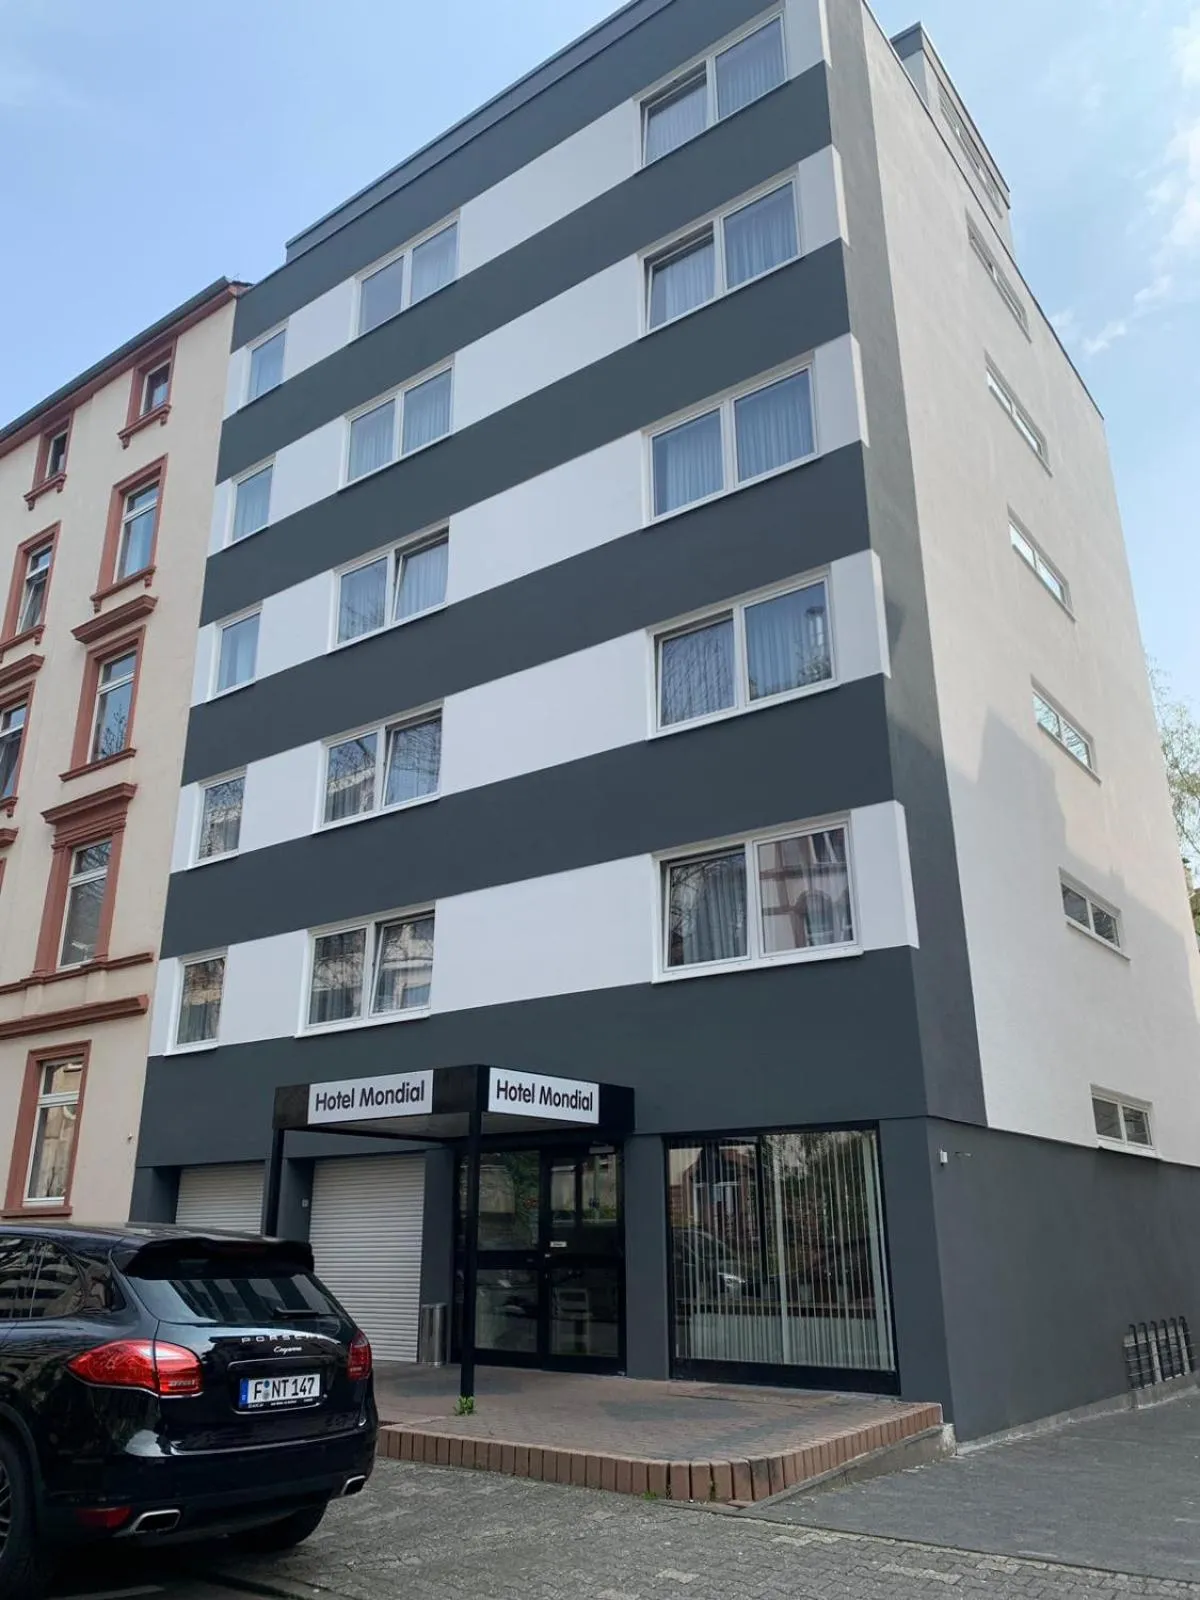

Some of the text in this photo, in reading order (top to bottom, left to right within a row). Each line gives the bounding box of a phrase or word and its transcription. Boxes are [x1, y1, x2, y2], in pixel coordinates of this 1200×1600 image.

[315, 1080, 425, 1112] Hotel Mondial
[496, 1079, 593, 1112] Hotel Mondial
[254, 1377, 315, 1400] F NT 147
